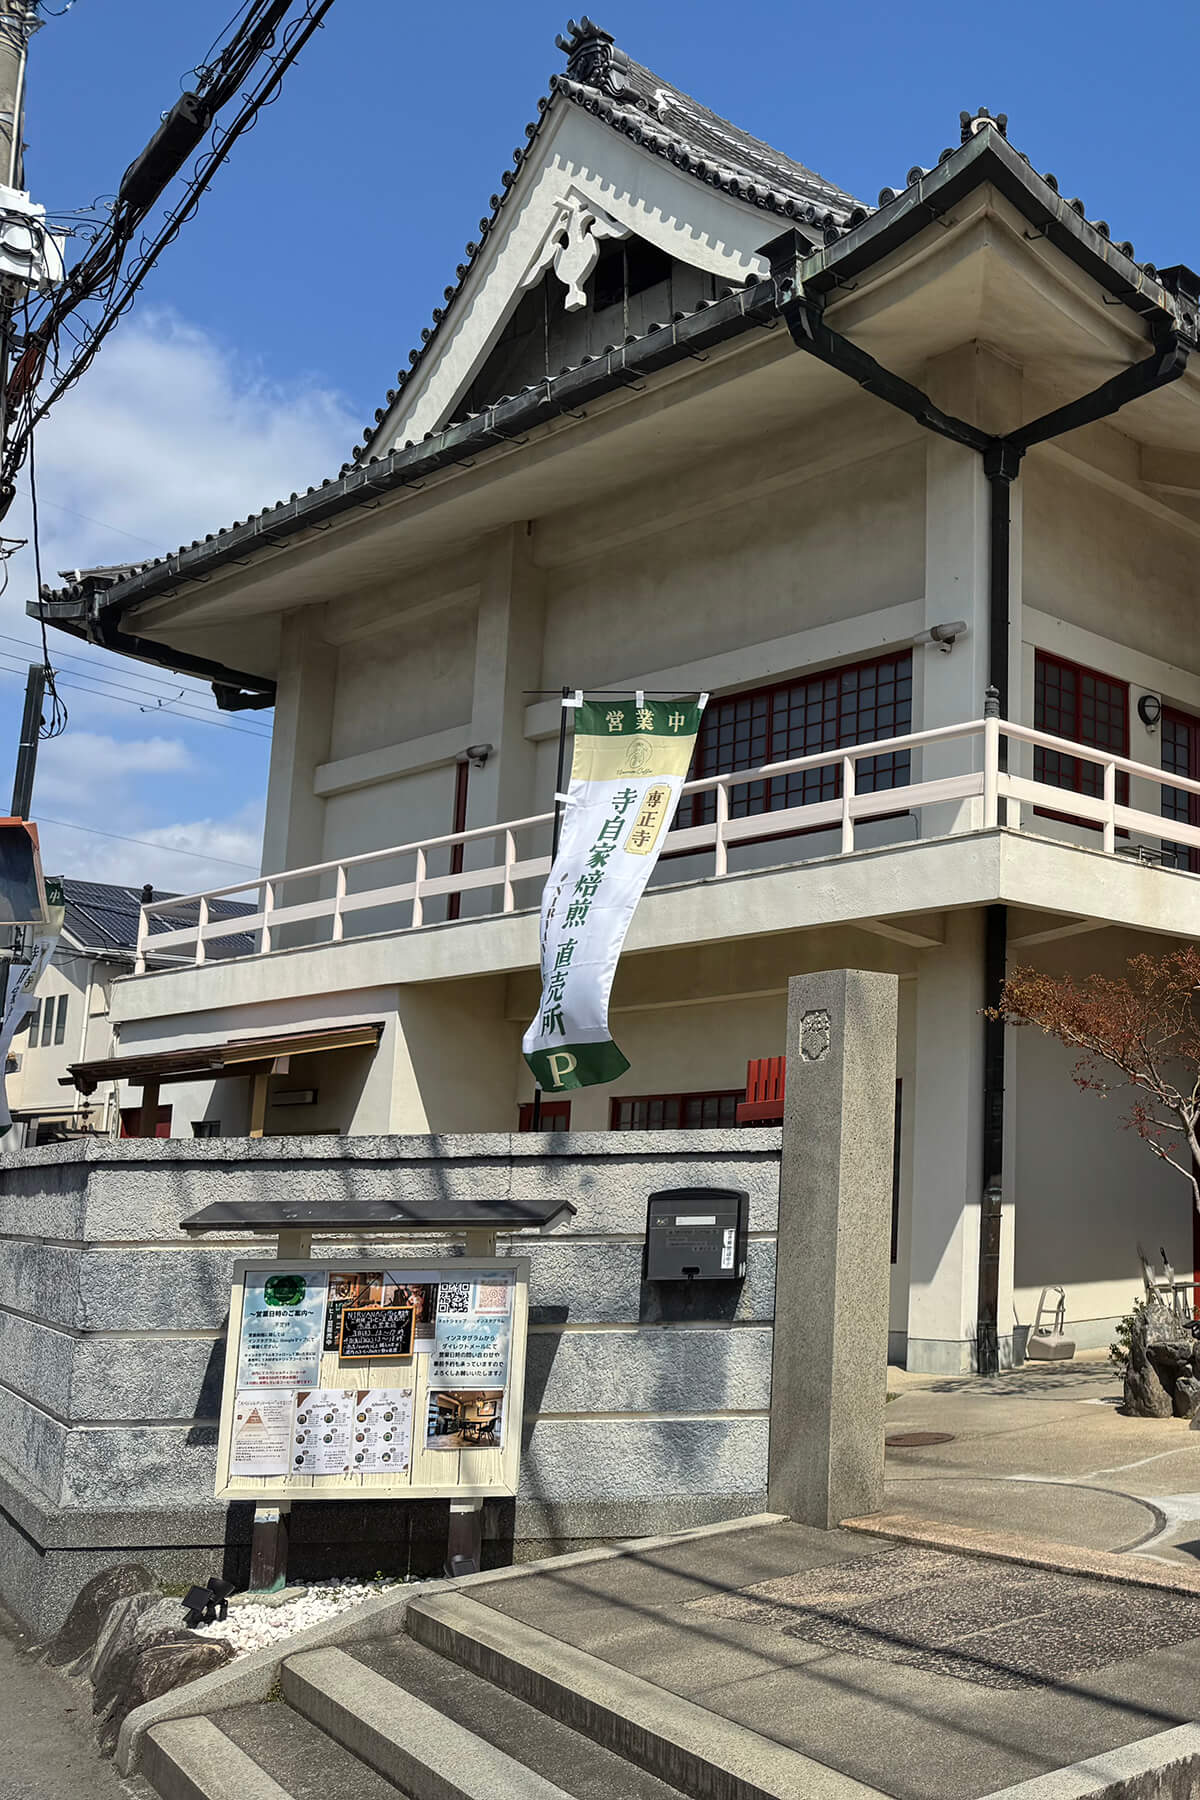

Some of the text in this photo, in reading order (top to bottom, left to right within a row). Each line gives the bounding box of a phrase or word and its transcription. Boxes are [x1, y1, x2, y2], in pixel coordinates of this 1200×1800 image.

[605, 709, 685, 733] 営業中
[631, 790, 665, 848] 専正寺
[541, 788, 638, 1037] 寺自家焙煎 直売所
[546, 1051, 577, 1087] P
